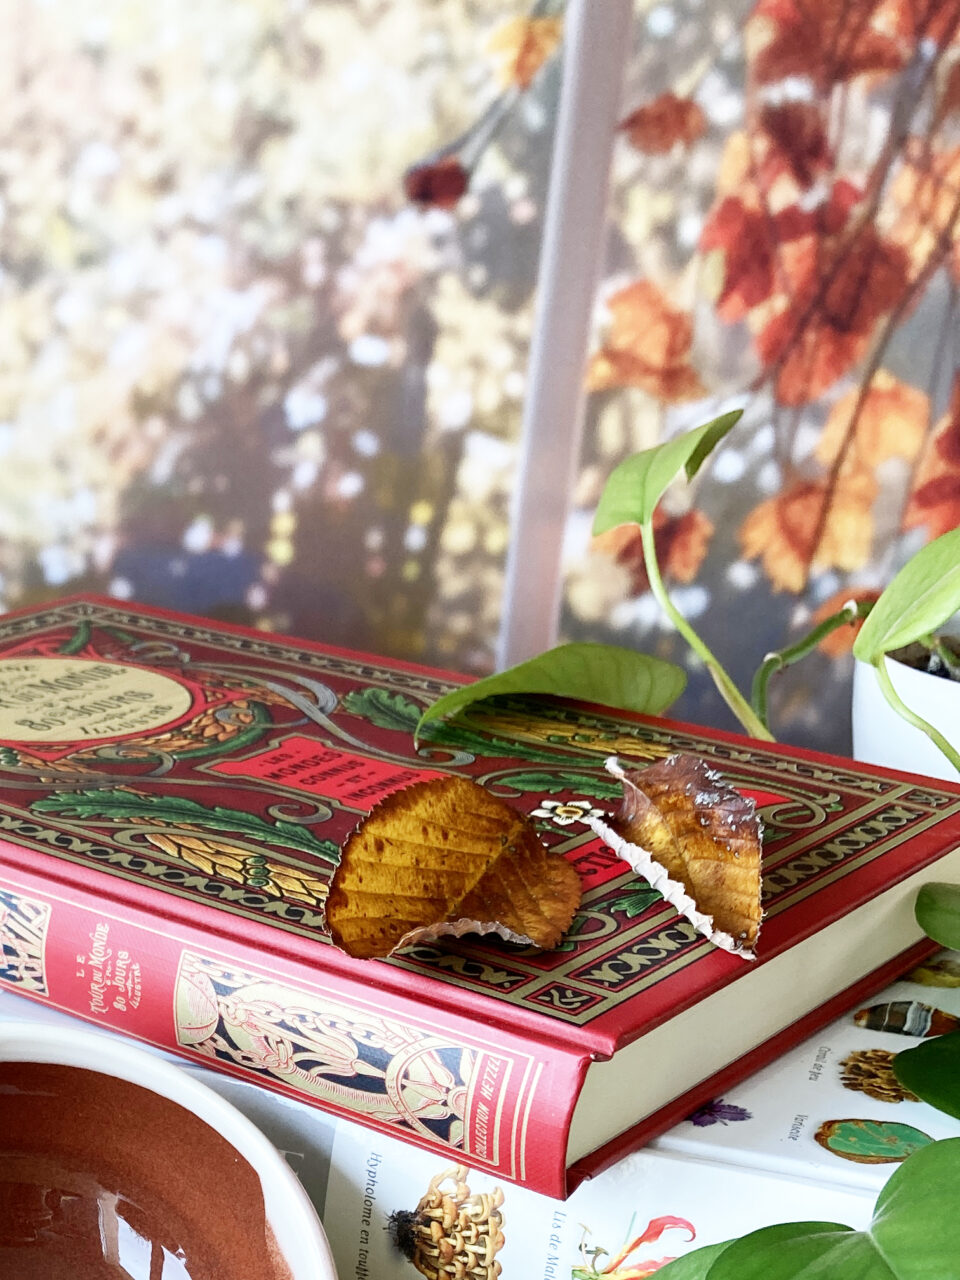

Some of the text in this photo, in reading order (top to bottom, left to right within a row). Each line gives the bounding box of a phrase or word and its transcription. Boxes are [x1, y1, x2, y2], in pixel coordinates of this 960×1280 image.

[14, 719, 66, 732] 80
[263, 751, 343, 781] MONDES
[298, 760, 366, 786] CONNUS
[343, 770, 421, 801] INCONNUS
[88, 923, 113, 969] MONDE
[76, 955, 85, 978] LE
[112, 951, 132, 1012] 80 JOURS
[88, 982, 109, 1014] TOUR
[474, 1056, 500, 1159] COLLECTION HETZEL
[361, 1152, 383, 1227] Hypholome
[552, 1210, 567, 1229] Lis
[360, 1229, 370, 1244] en
[549, 1234, 562, 1250] de
